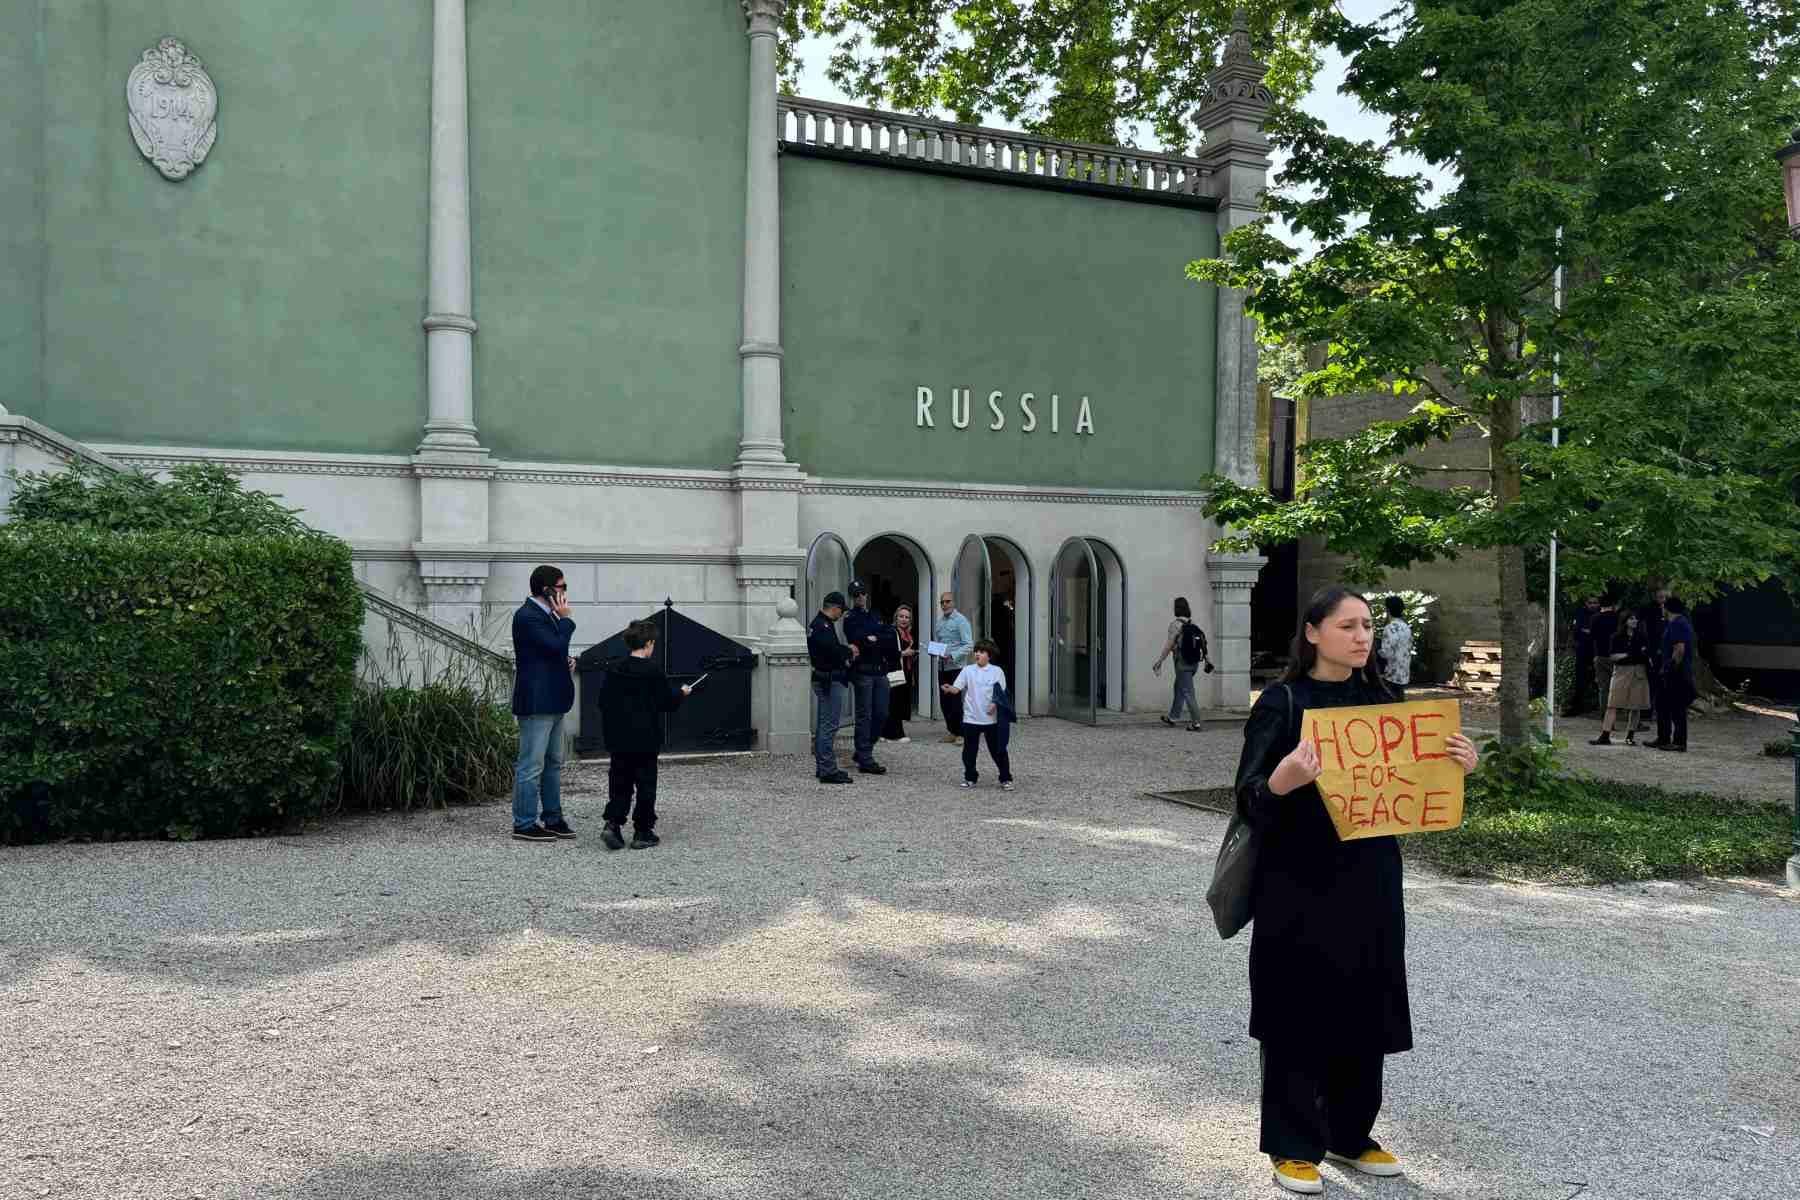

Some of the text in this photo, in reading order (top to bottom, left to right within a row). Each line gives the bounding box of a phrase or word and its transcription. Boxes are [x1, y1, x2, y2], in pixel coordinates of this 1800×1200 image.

[150, 96, 195, 122] 1914
[916, 386, 1095, 434] RUSSIA
[1312, 714, 1449, 770] HOPE
[1353, 765, 1416, 792] FOR
